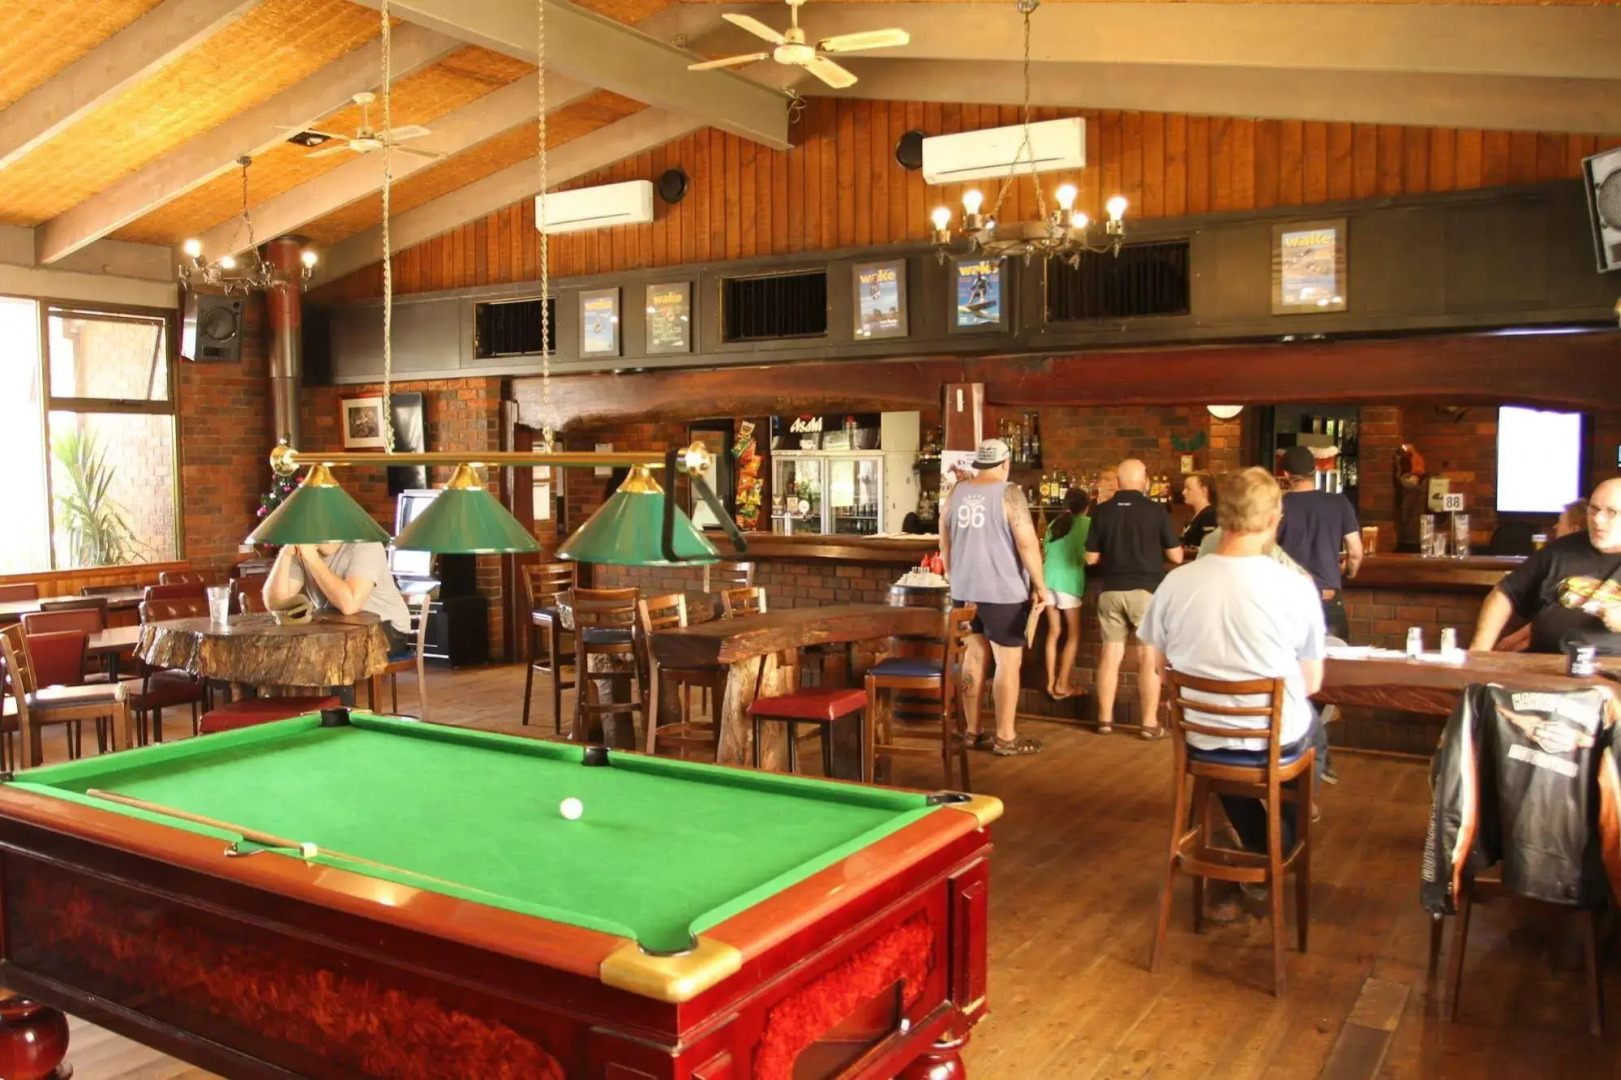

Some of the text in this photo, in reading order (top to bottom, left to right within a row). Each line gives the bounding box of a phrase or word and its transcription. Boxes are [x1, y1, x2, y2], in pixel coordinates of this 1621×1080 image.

[859, 269, 896, 285] wake
[653, 292, 683, 304] wake
[790, 416, 823, 433] Asahi
[1446, 496, 1460, 508] 88
[957, 505, 986, 529] 96
